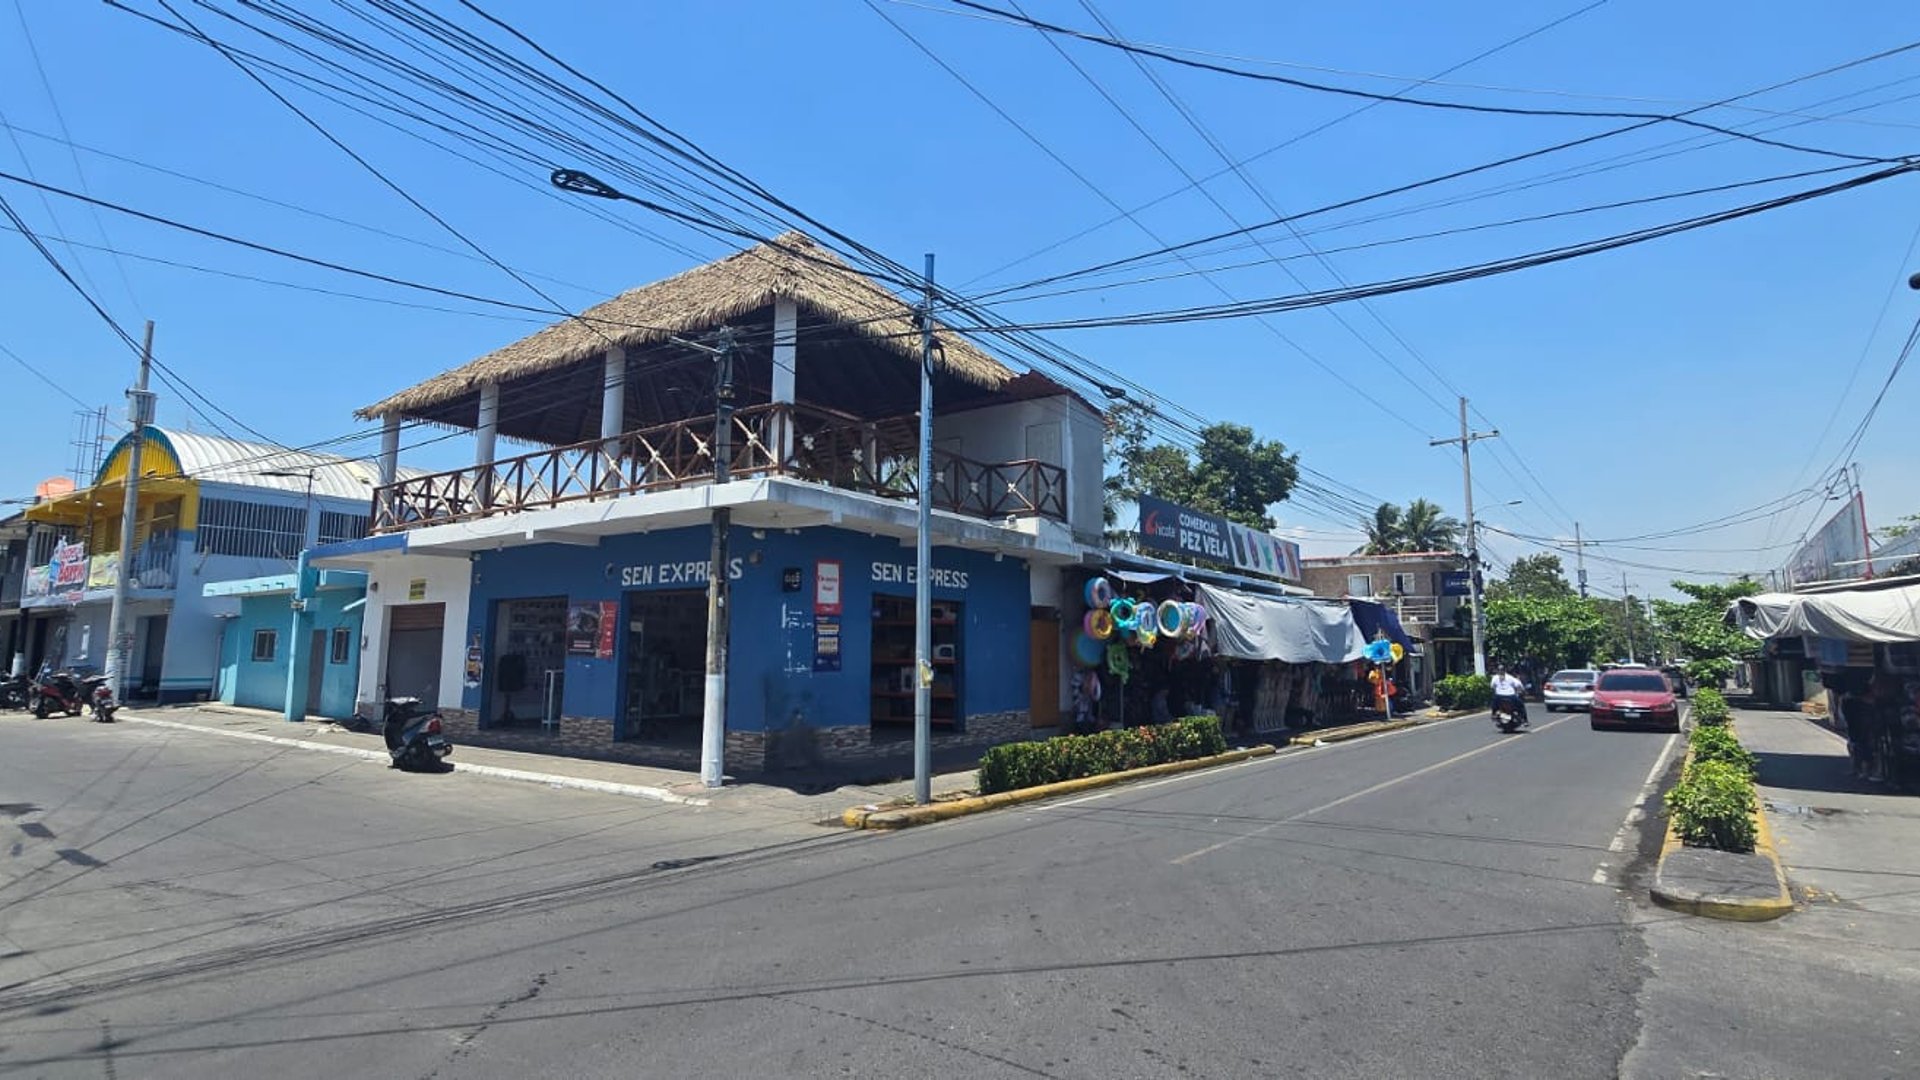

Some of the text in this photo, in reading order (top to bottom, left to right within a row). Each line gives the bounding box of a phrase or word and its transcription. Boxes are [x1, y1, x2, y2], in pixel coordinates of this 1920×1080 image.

[1179, 513, 1219, 536] COMERCIAL
[1180, 528, 1229, 559] PEZ VELA
[621, 558, 743, 586] SEN EXPRES
[871, 562, 969, 589] SEN EPRESS
